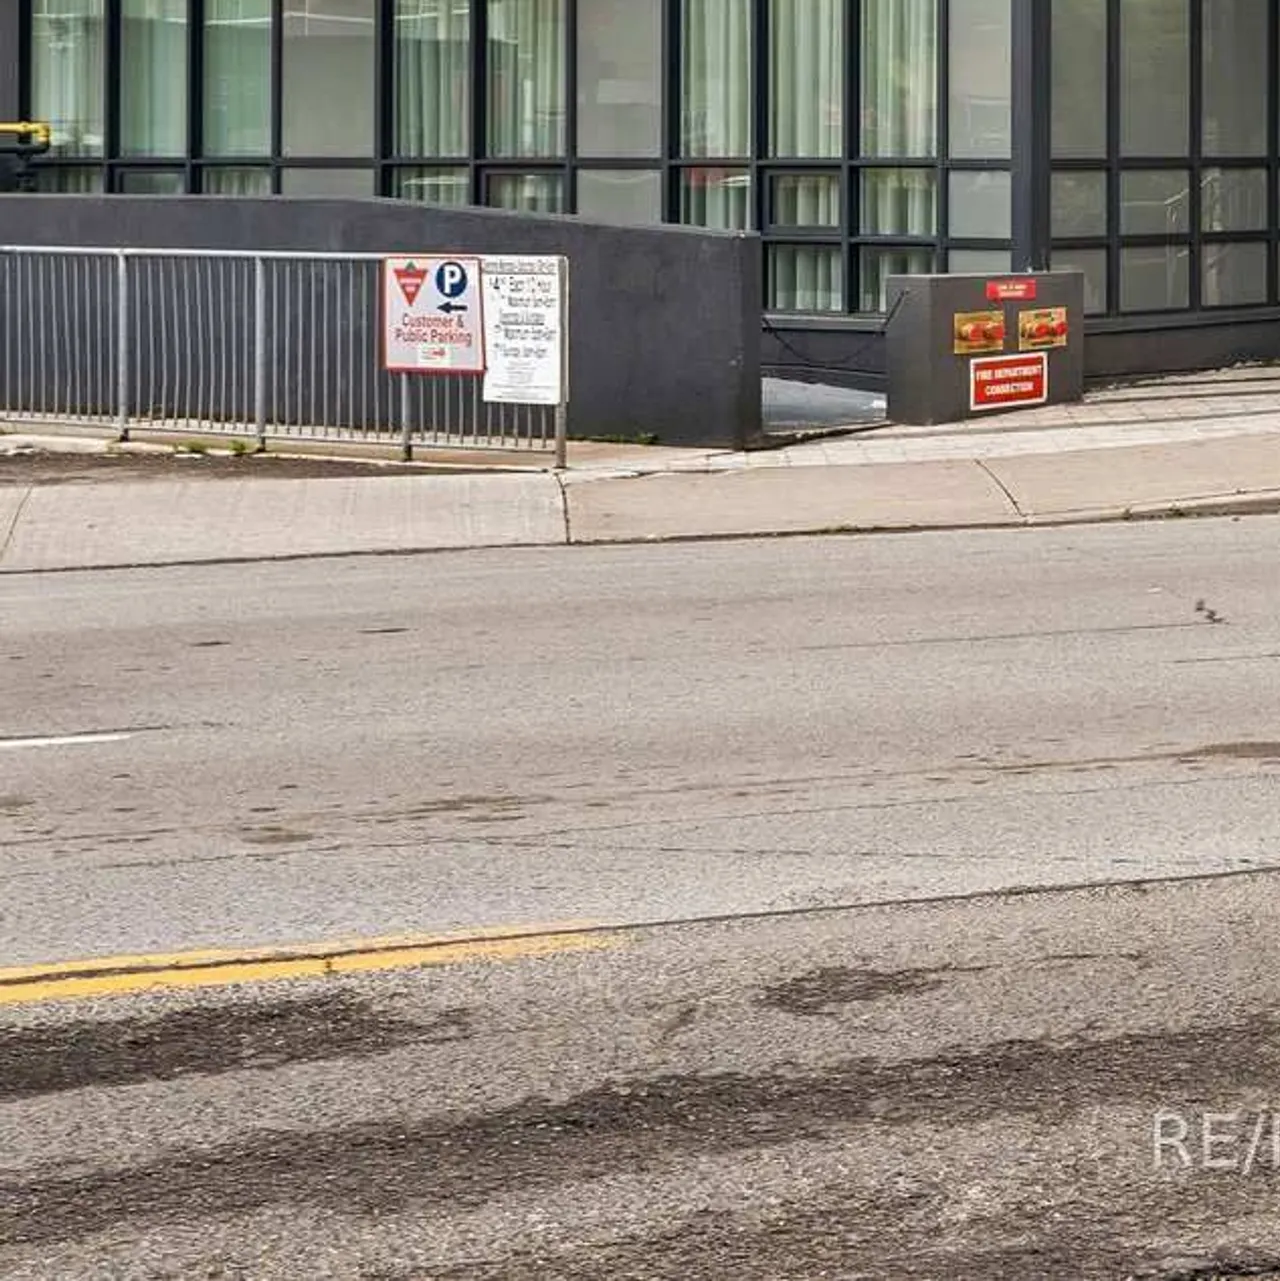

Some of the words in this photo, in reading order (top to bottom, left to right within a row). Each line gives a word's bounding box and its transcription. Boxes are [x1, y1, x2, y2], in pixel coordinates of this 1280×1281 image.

[402, 312, 454, 328] Customer
[456, 314, 465, 329] &
[395, 327, 428, 342] Public
[430, 328, 473, 348] Parking
